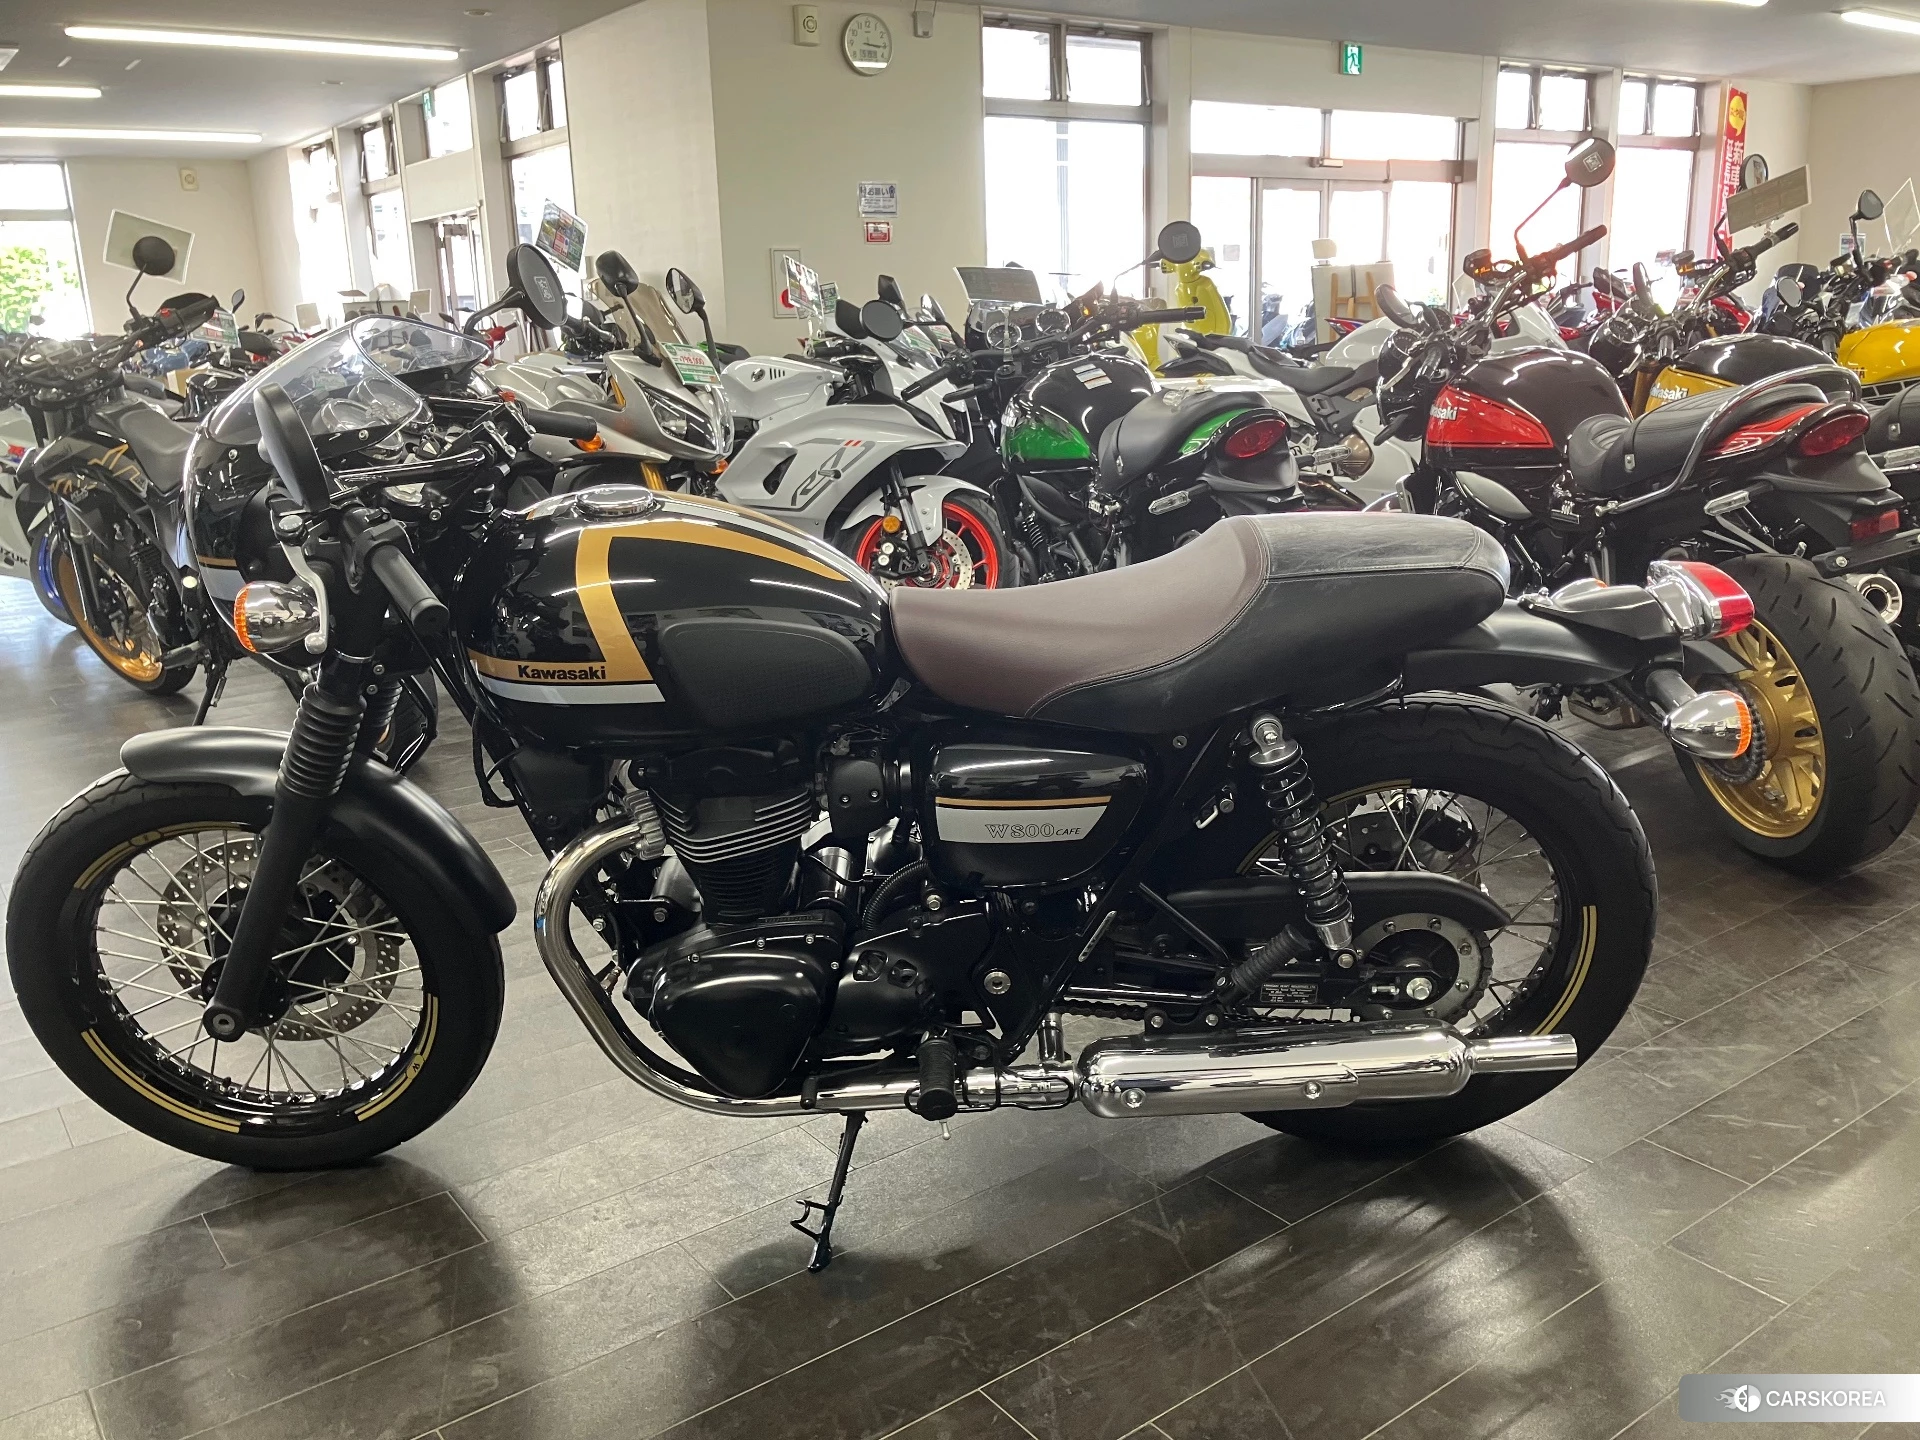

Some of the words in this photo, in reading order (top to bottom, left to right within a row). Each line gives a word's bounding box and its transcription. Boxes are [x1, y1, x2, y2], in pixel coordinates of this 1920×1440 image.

[518, 665, 606, 681] Kawasaki
[985, 823, 1055, 839] W800
[1055, 827, 1082, 836] CAFE
